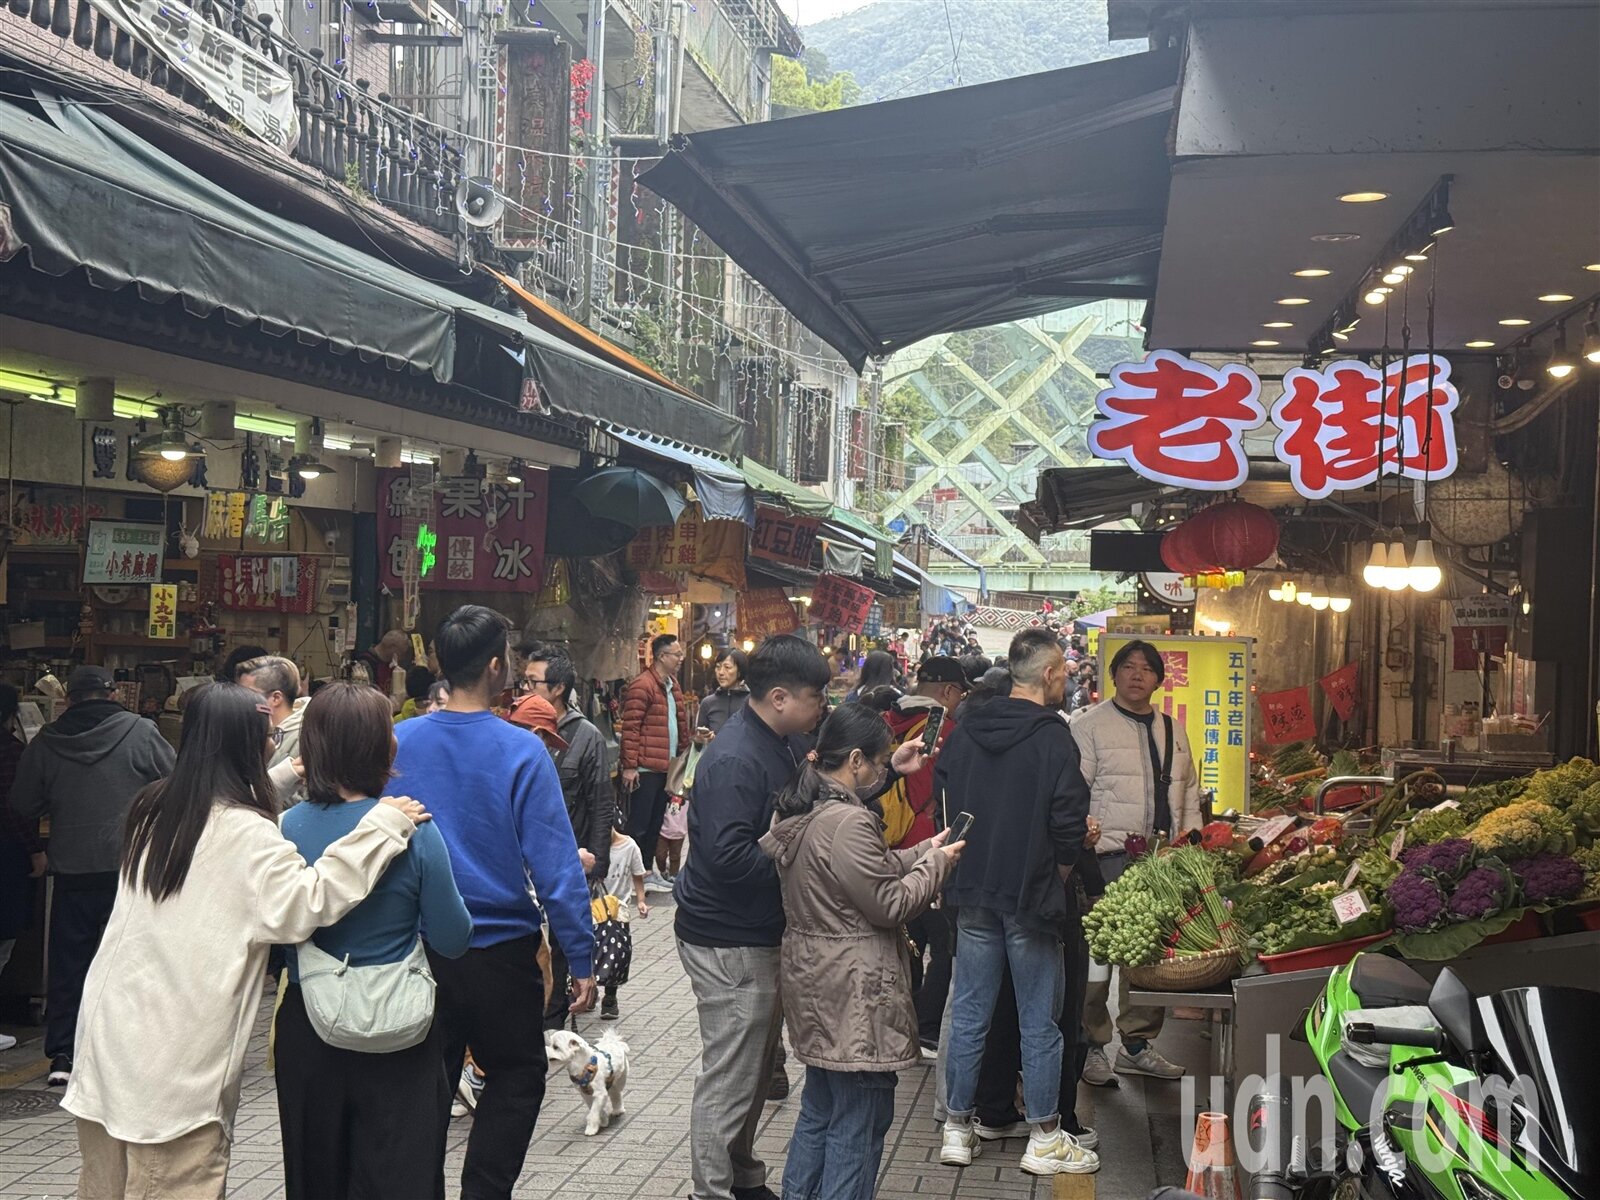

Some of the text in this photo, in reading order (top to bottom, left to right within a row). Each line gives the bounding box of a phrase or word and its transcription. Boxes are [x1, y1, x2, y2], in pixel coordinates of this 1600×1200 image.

[1093, 357, 1452, 492] 老街
[752, 517, 815, 563] 紅豆餅
[153, 588, 174, 629] 小丸子
[1164, 581, 1183, 597] 味
[1227, 651, 1245, 746] 五十年老店
